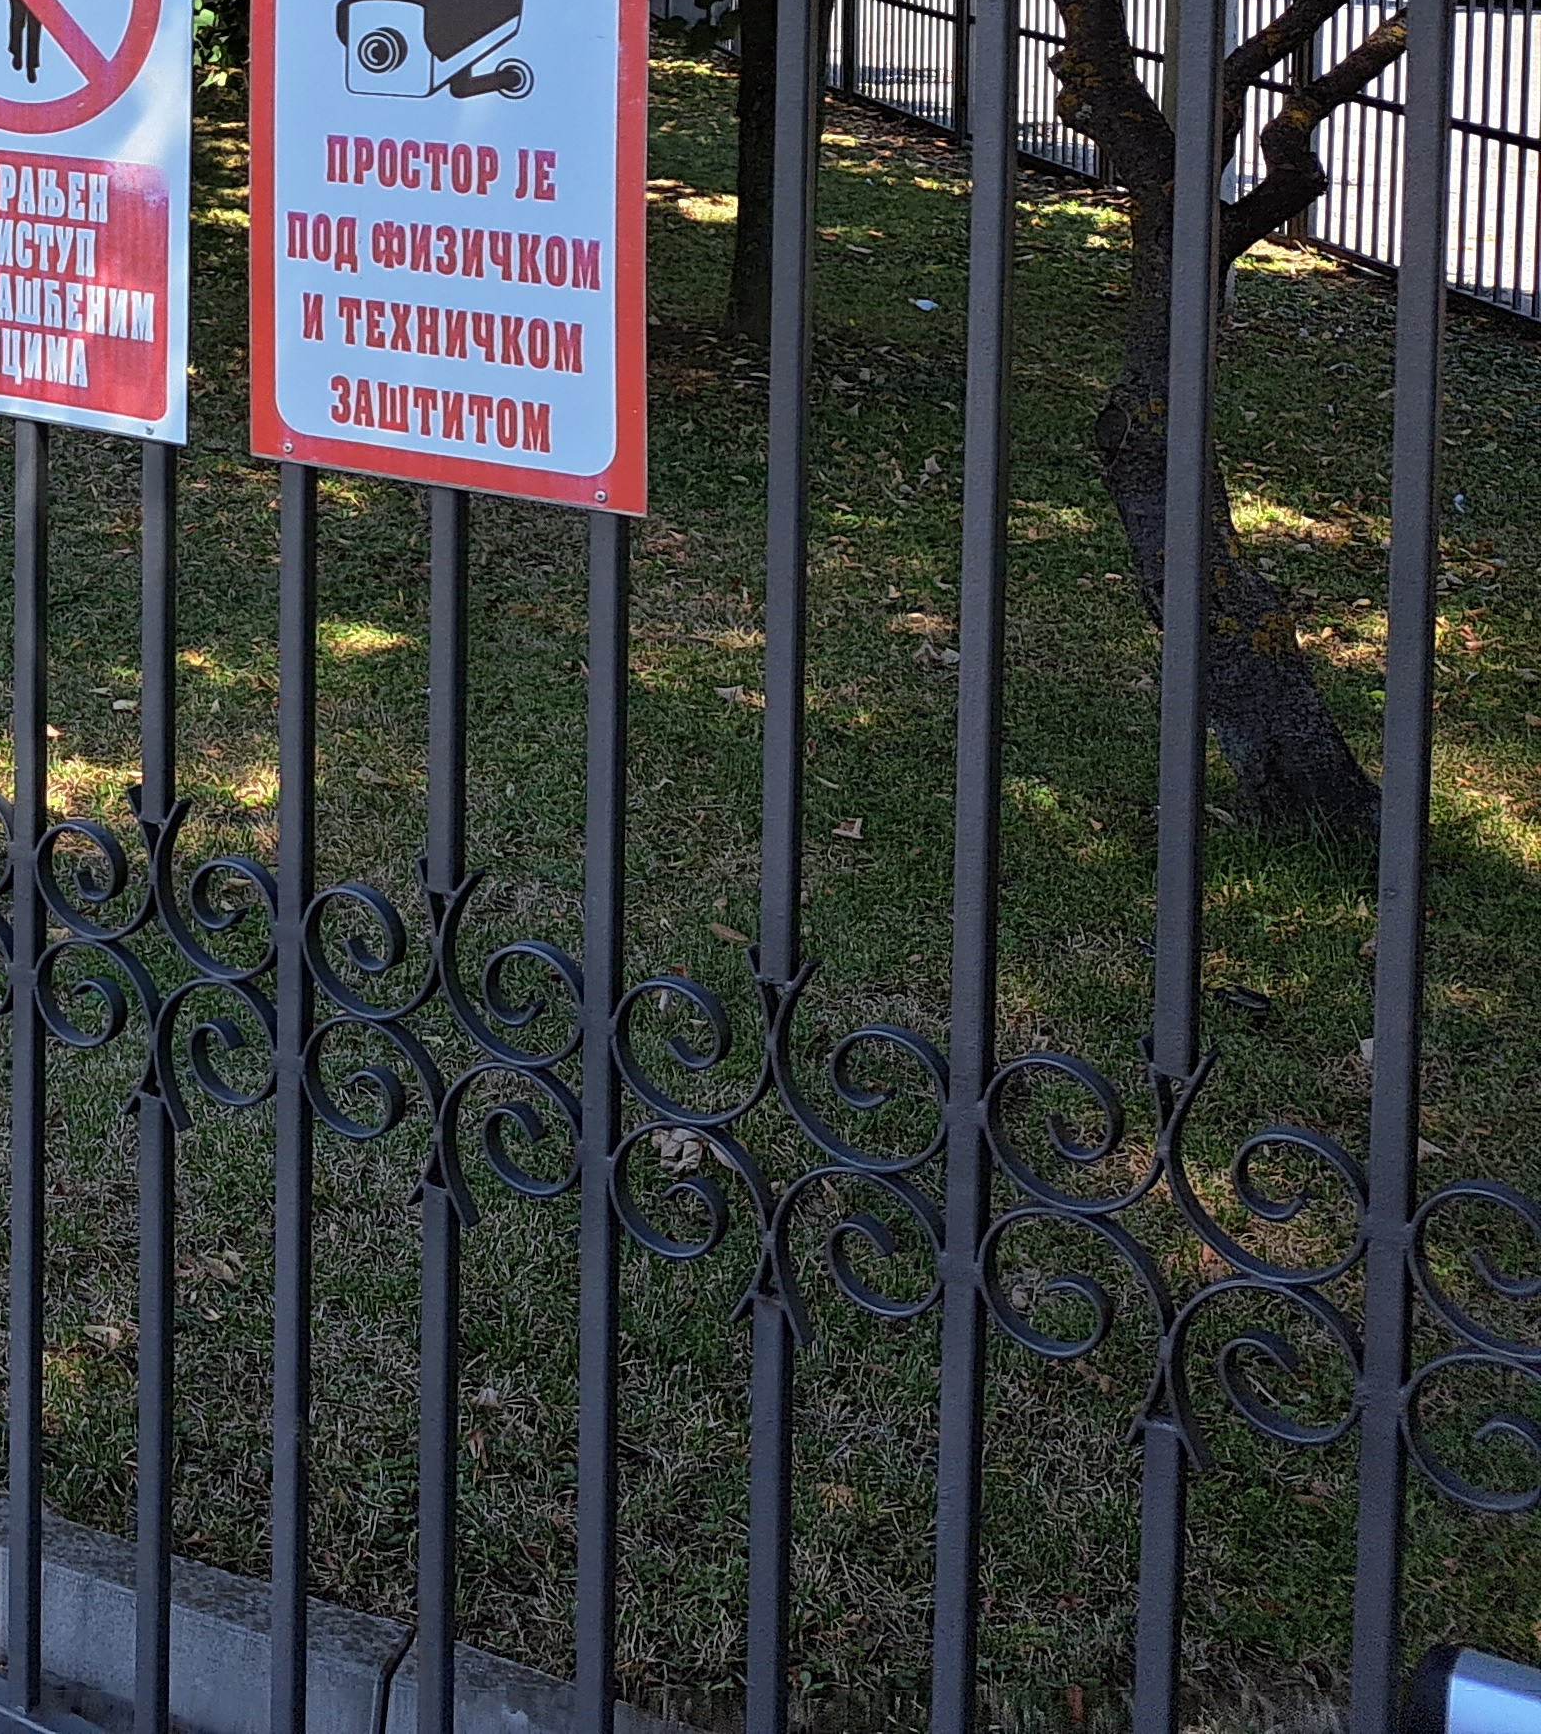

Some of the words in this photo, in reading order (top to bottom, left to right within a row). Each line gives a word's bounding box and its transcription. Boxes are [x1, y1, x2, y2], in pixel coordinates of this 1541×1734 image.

[326, 134, 499, 195] ПРОСТОР
[515, 149, 557, 201] ЈЕ
[286, 211, 358, 273] ПОД
[372, 220, 601, 291] ФИЗИЧКОМ
[302, 292, 324, 341] И
[338, 296, 583, 374] ТЕХНИЧКОМ
[329, 375, 551, 454] ЗАШТИТОМ
